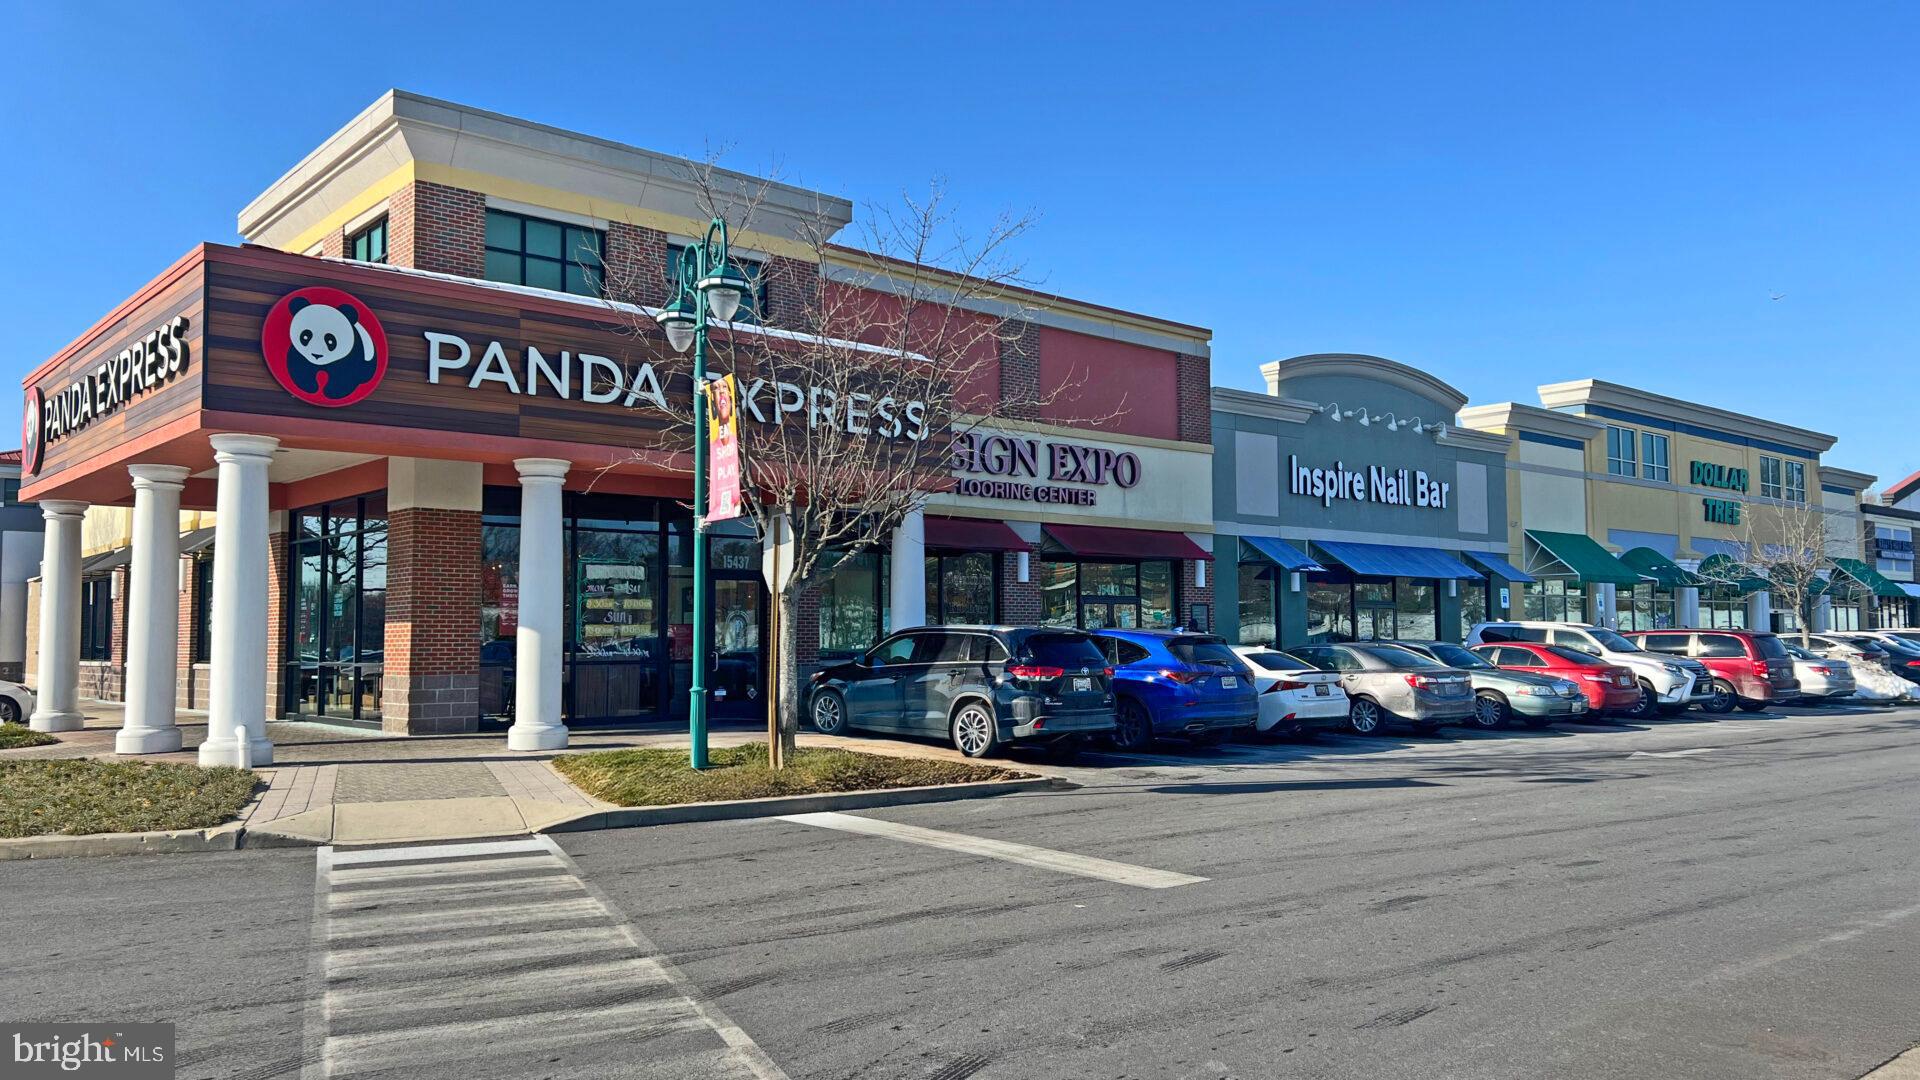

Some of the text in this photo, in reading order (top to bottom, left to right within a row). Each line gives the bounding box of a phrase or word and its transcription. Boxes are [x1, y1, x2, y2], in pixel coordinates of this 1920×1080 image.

[44, 316, 187, 443] PANDA EXPRESS
[424, 331, 930, 441] PANDA XPRESS
[716, 444, 735, 460] SHOP
[1047, 443, 1142, 489] EXPO
[717, 463, 736, 480] PLAY
[1289, 455, 1449, 509] Inspire Nail Bar
[1690, 461, 1749, 494] DOLLAR
[1035, 485, 1097, 506] CENTER
[1703, 498, 1742, 525] TREE
[723, 555, 750, 569] 15437
